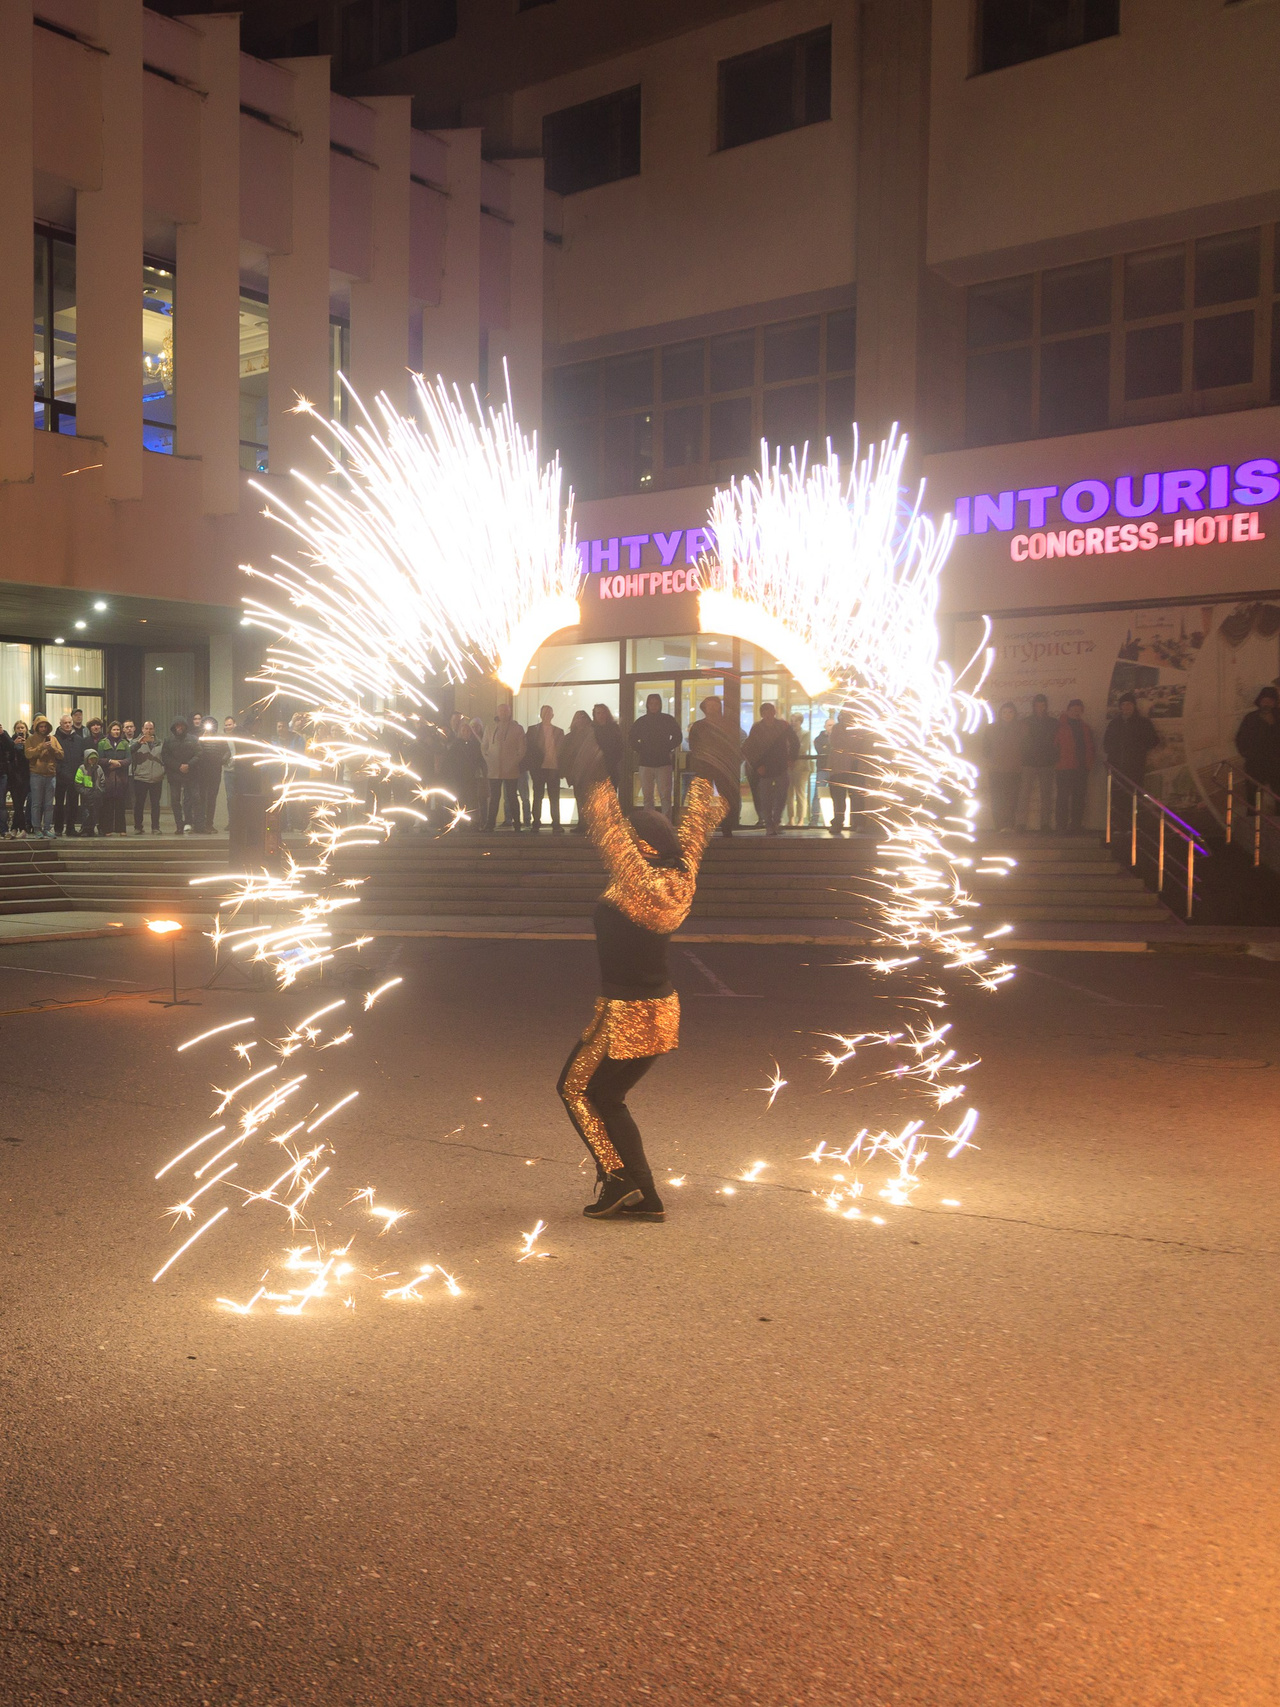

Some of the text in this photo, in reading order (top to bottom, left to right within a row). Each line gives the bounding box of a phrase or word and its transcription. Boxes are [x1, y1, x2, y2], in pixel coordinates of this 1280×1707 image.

[955, 458, 1280, 536] INTOURIS
[565, 523, 732, 574] НТУР
[1010, 511, 1265, 562] CONGRESS-HOTEL
